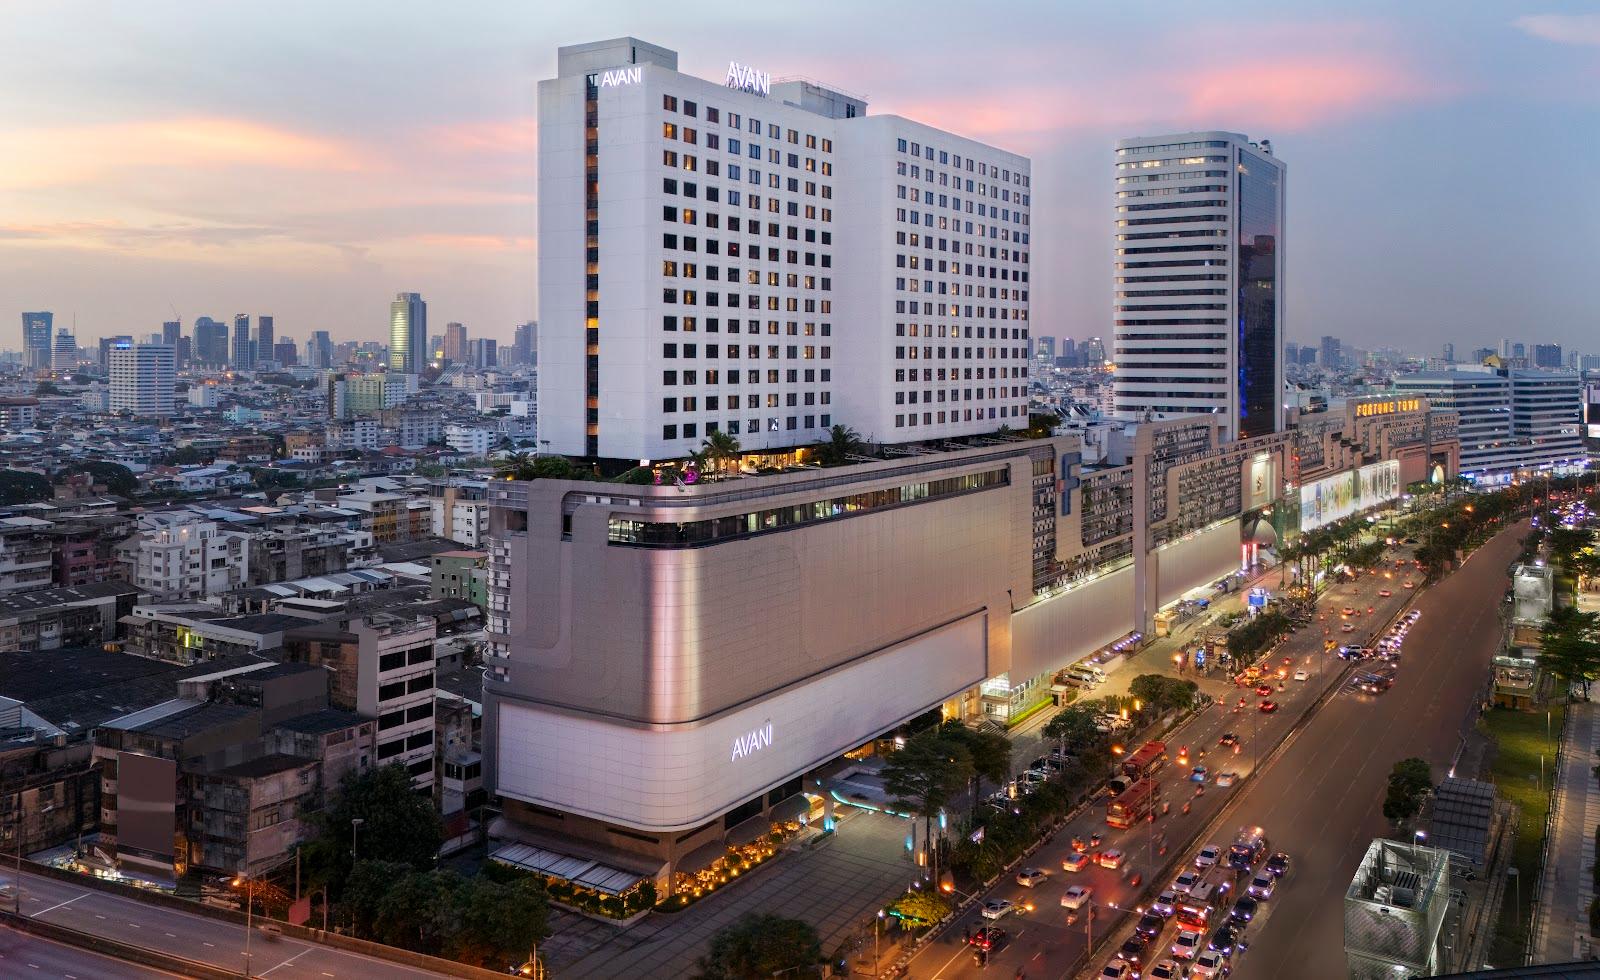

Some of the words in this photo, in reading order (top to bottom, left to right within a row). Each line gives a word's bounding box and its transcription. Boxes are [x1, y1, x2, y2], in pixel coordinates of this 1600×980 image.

[601, 67, 642, 88] AVANI
[725, 60, 770, 95] AVANI
[1356, 401, 1395, 417] FORTUNE
[1397, 399, 1419, 412] TOWN
[731, 723, 772, 762] AVANI
